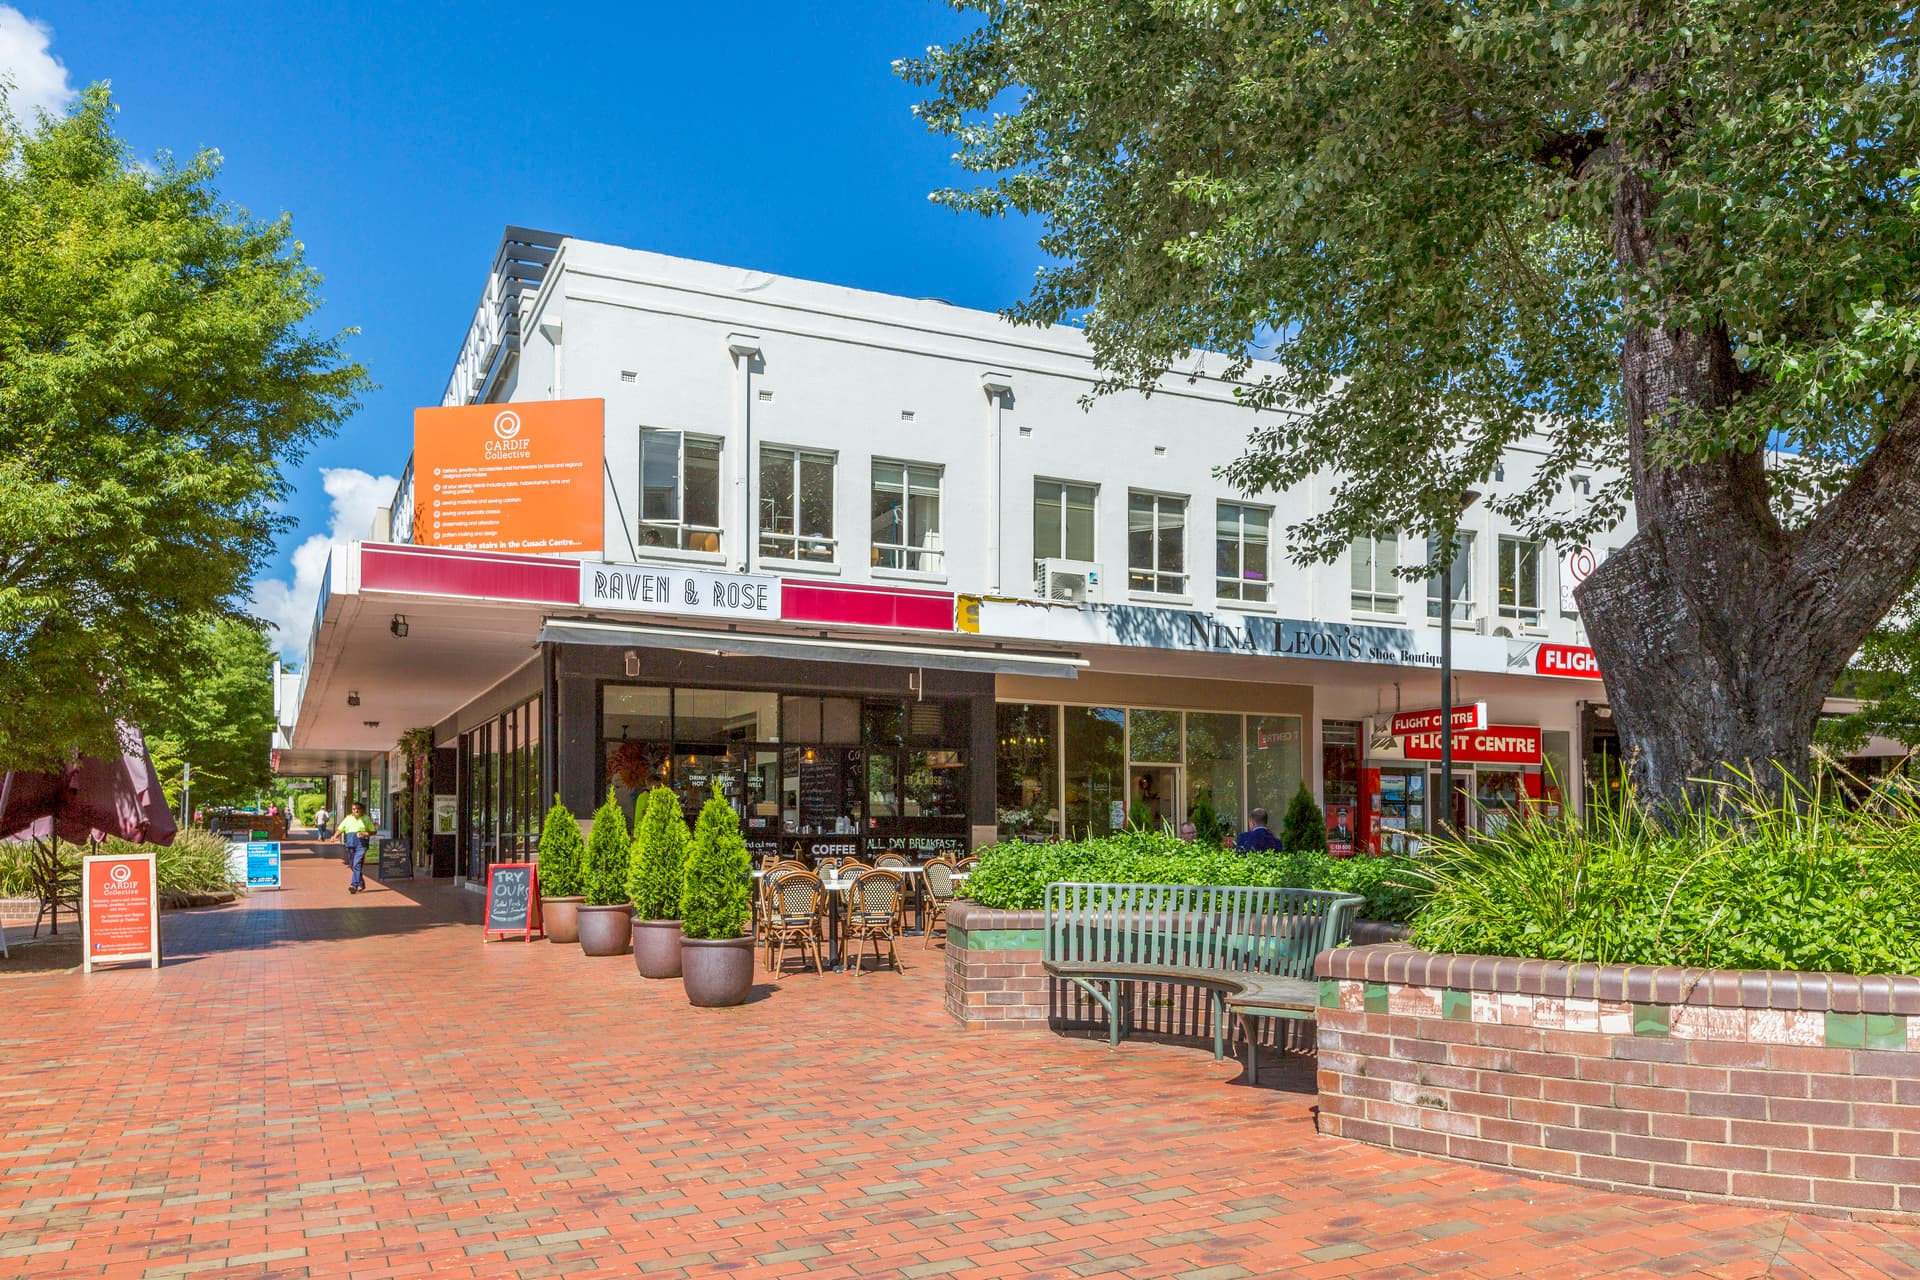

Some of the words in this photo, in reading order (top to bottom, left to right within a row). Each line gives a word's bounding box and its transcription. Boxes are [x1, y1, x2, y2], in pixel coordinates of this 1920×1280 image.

[485, 439, 530, 452] CARDIF
[485, 450, 531, 461] Collective
[465, 541, 477, 549] the
[479, 541, 498, 549] stairs
[499, 541, 507, 549] in
[508, 540, 520, 548] the
[522, 538, 548, 548] Cusack
[594, 570, 670, 603] RAVEN
[684, 578, 699, 605] &
[713, 580, 769, 611] ROSE
[1368, 647, 1396, 662] Shoe
[1401, 650, 1441, 667] Boutiqu
[1545, 650, 1599, 672] FLIGH
[1395, 716, 1431, 730] FLIGHT
[1475, 735, 1536, 753] CENTRE
[811, 844, 856, 855] COFFEE
[867, 838, 886, 849] ALL
[889, 838, 906, 849] DAY
[909, 838, 957, 849] BREAKFAST
[494, 870, 524, 882] TRY
[103, 881, 139, 890] CARDIF
[495, 884, 529, 900] OURS
